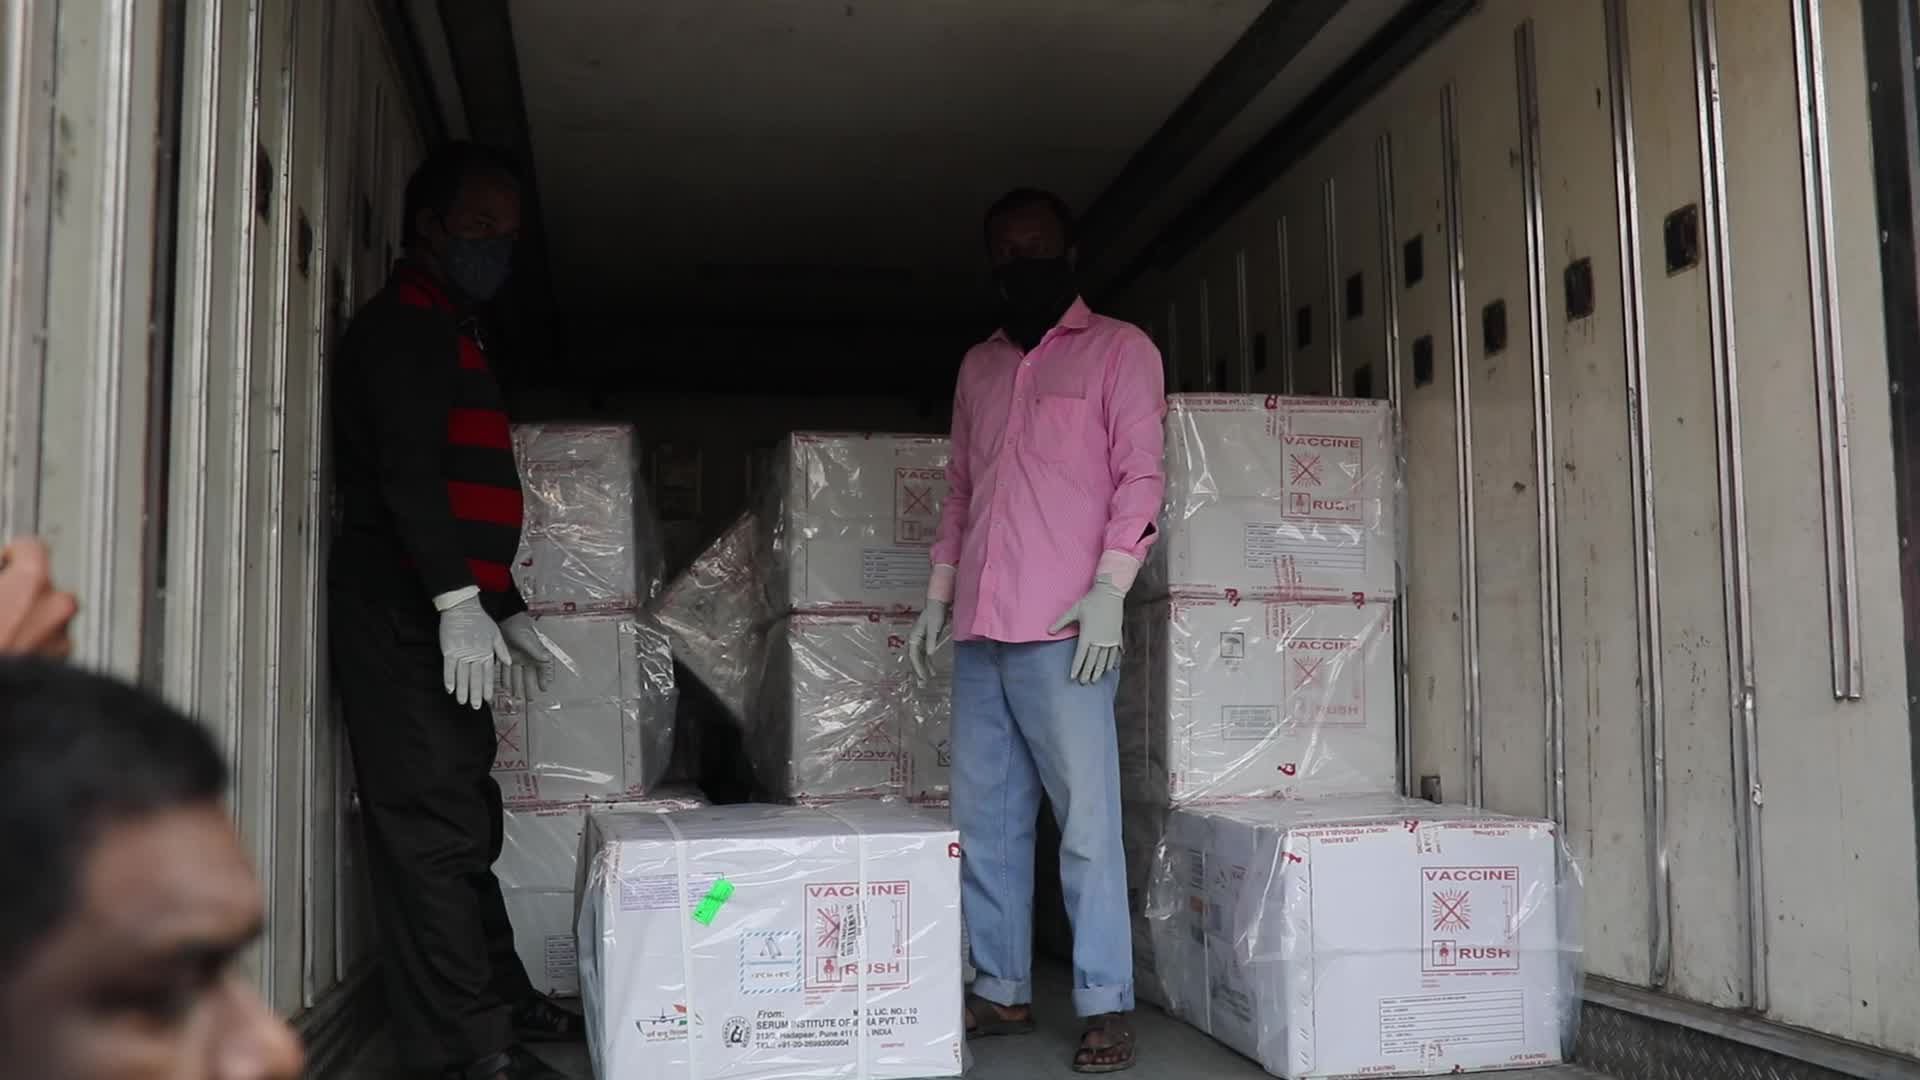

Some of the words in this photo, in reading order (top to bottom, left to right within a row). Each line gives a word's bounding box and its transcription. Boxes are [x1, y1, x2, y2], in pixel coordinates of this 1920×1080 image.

[1284, 437, 1361, 449] VACCINE
[899, 471, 945, 481] VACC
[1287, 640, 1360, 650] VACCI
[1424, 870, 1516, 881] VACCINE
[1459, 947, 1512, 959] RUSH
[757, 1010, 785, 1019] From:
[756, 1020, 788, 1030] SERUM
[838, 1018, 850, 1027] OF
[879, 1016, 898, 1026] PVT.
[900, 1016, 919, 1025] LTD.
[819, 1030, 838, 1039] Pune
[871, 1028, 892, 1036] INDIA
